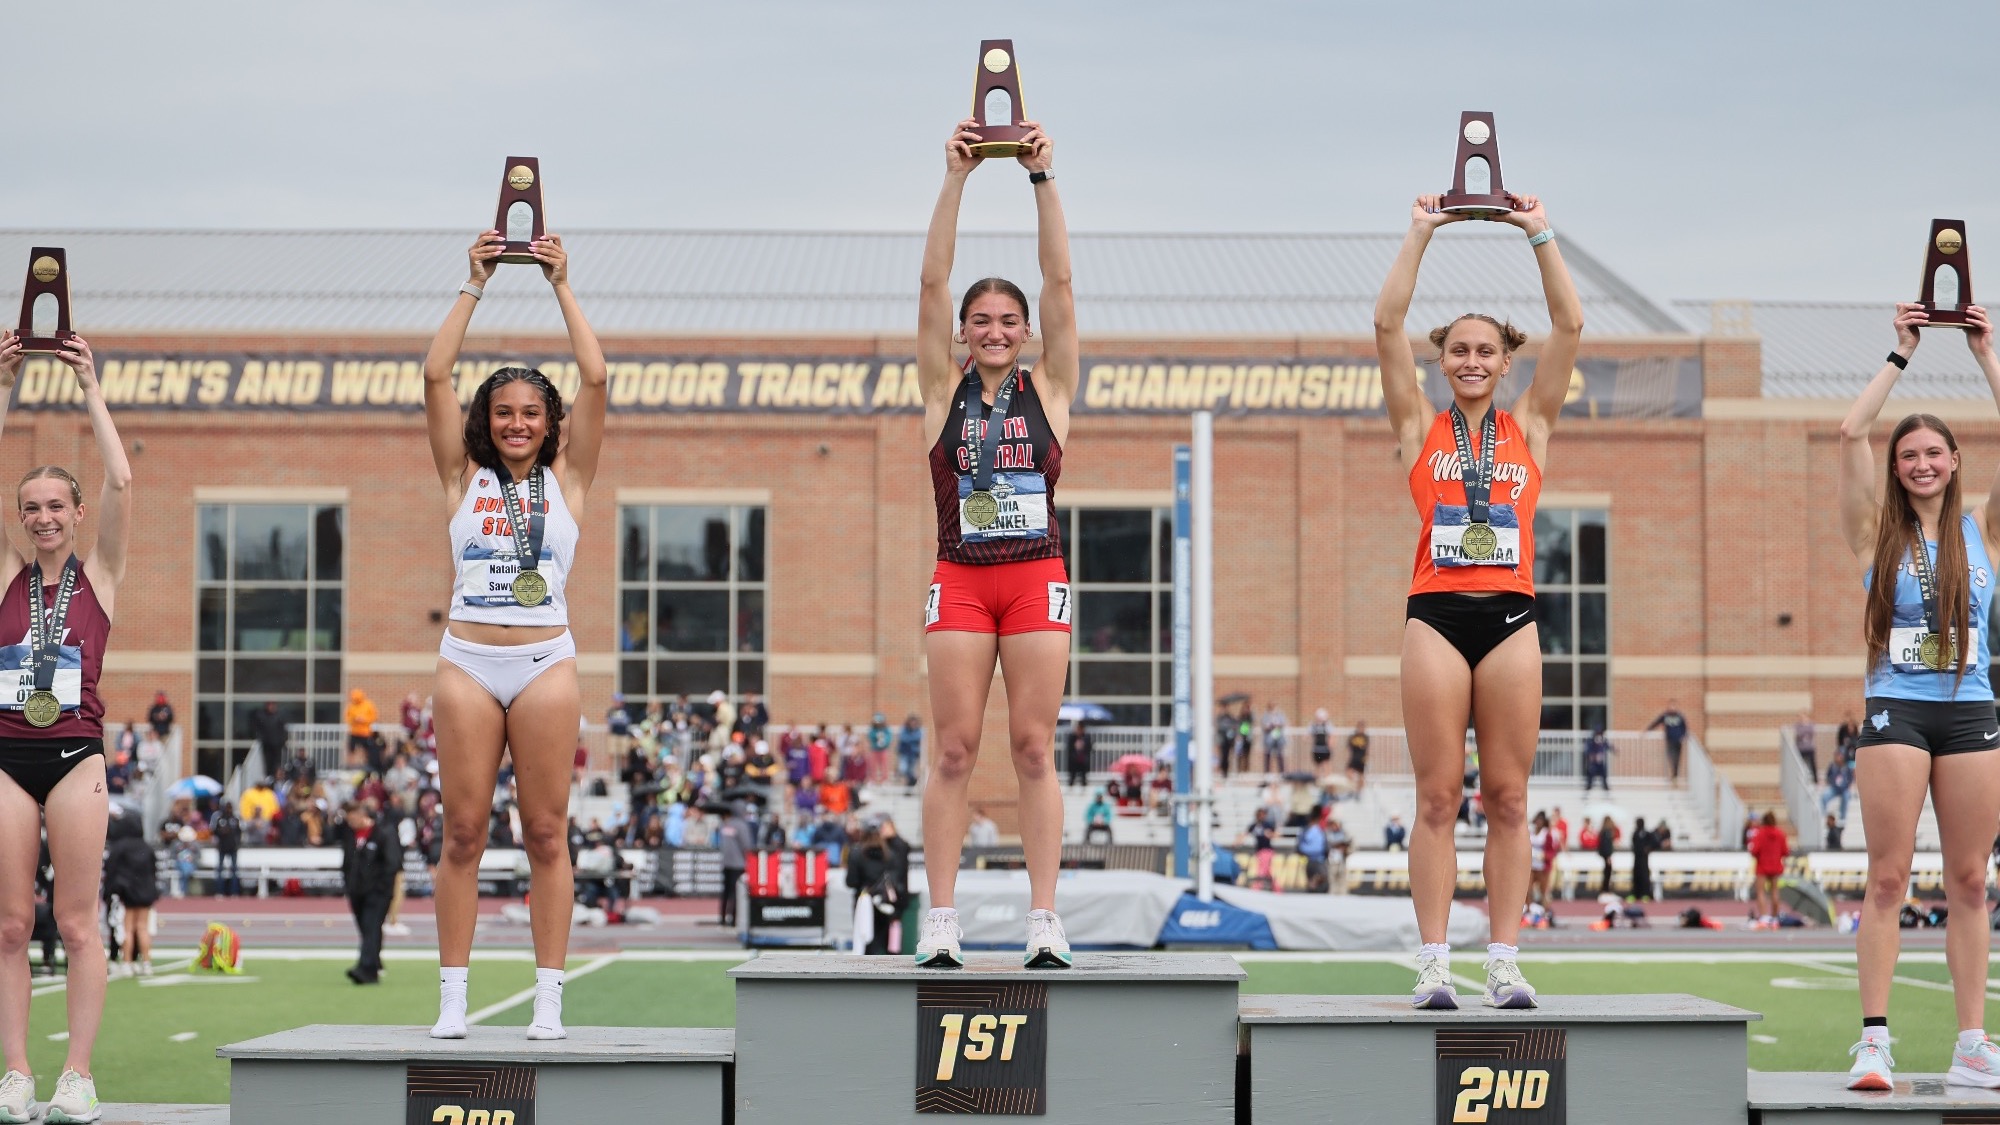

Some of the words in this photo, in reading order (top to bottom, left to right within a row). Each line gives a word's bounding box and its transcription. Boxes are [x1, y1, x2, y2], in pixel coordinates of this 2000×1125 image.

[100, 359, 232, 404] MEN'S
[233, 361, 325, 405] AND
[331, 361, 528, 405] WOMN'
[537, 361, 729, 406] OUDOOR
[737, 363, 871, 407] TRACK
[871, 363, 924, 407] AN
[957, 444, 1034, 470] CTRAL
[507, 482, 532, 556] ALL-AMERICAN
[978, 515, 1029, 531] ENKEL
[998, 501, 1019, 512] IVIA
[489, 582, 513, 592] Sawy
[490, 565, 521, 574] Natalia
[30, 577, 41, 650] ALL-AMERICAN
[53, 570, 76, 645] ALL-AMERICAN
[1055, 587, 1067, 619] 7
[936, 1013, 1028, 1081] 1ST
[1453, 1066, 1549, 1123] 2ND
